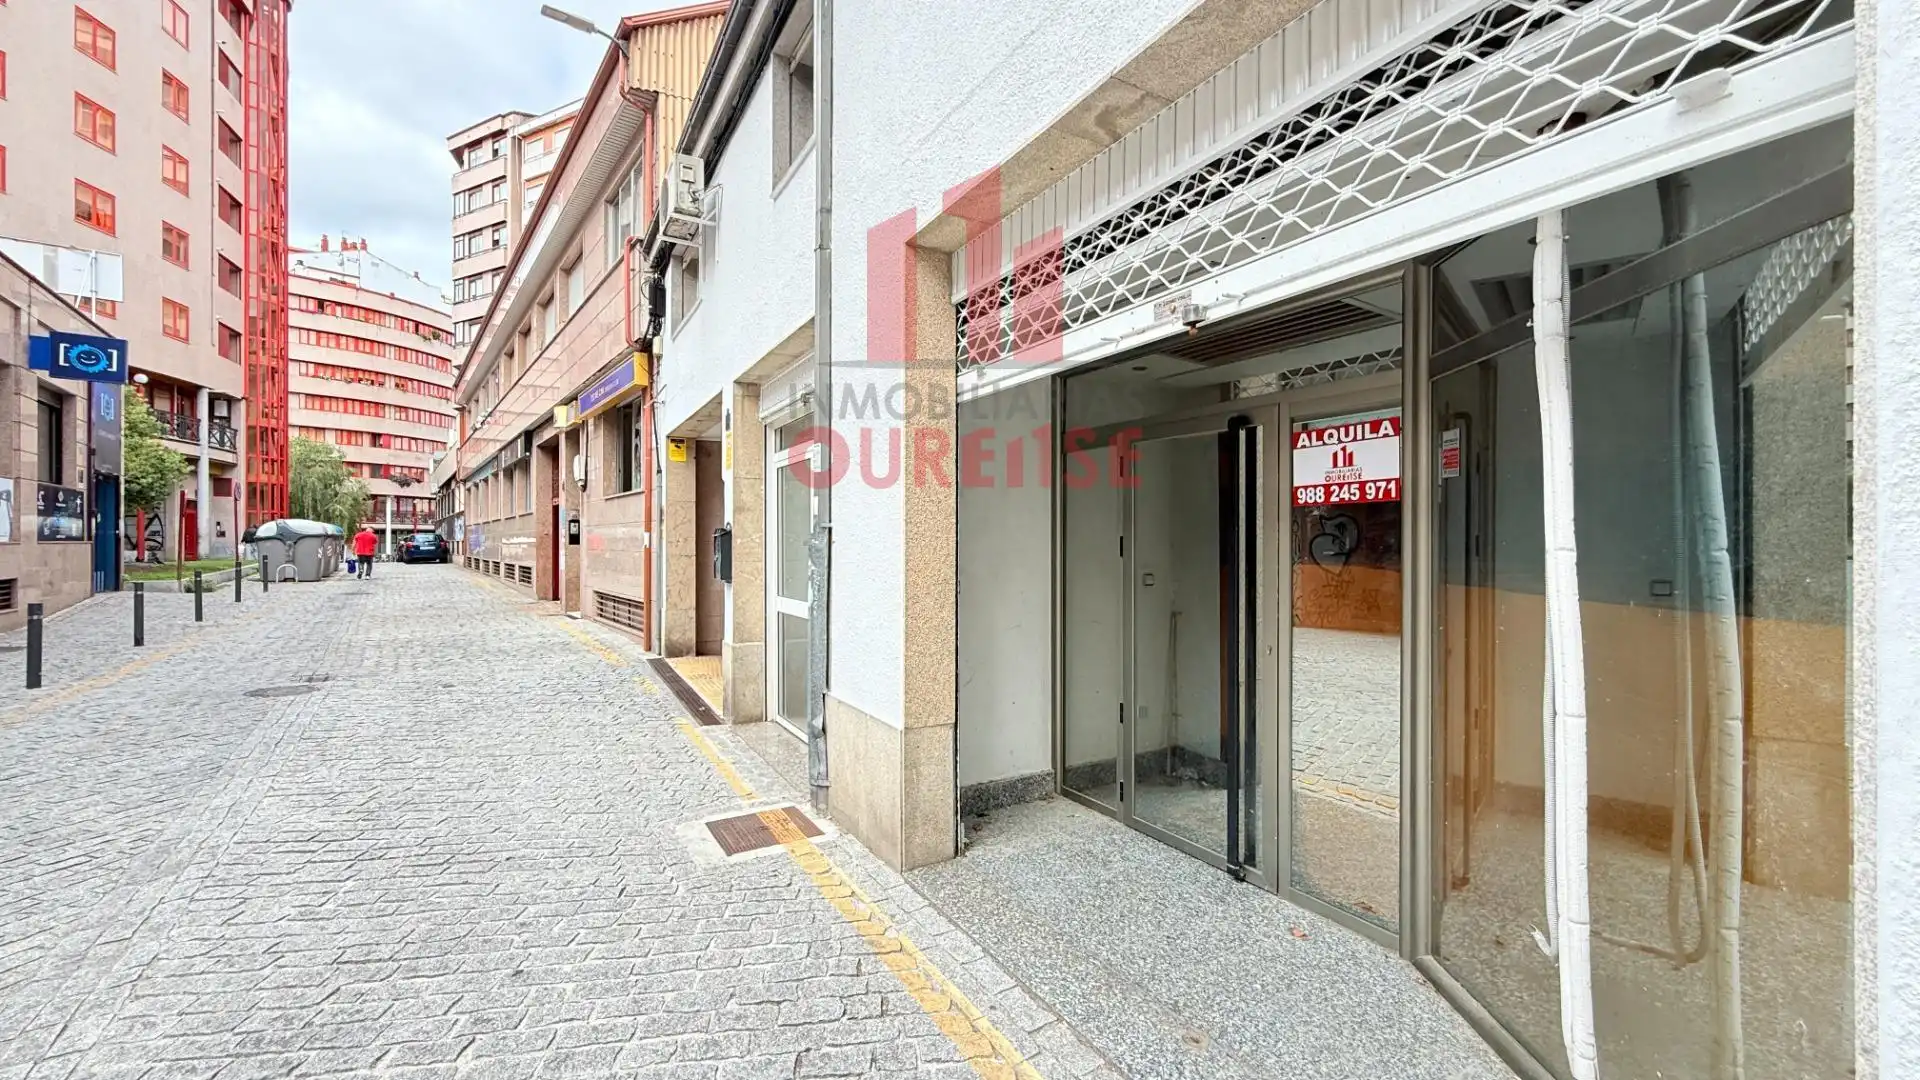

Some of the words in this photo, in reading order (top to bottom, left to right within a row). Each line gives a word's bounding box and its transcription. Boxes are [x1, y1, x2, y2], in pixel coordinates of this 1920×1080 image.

[1296, 420, 1395, 449] ALQUILA
[1296, 486, 1326, 504] 988
[1330, 483, 1360, 502] 245
[1365, 480, 1396, 500] 971
